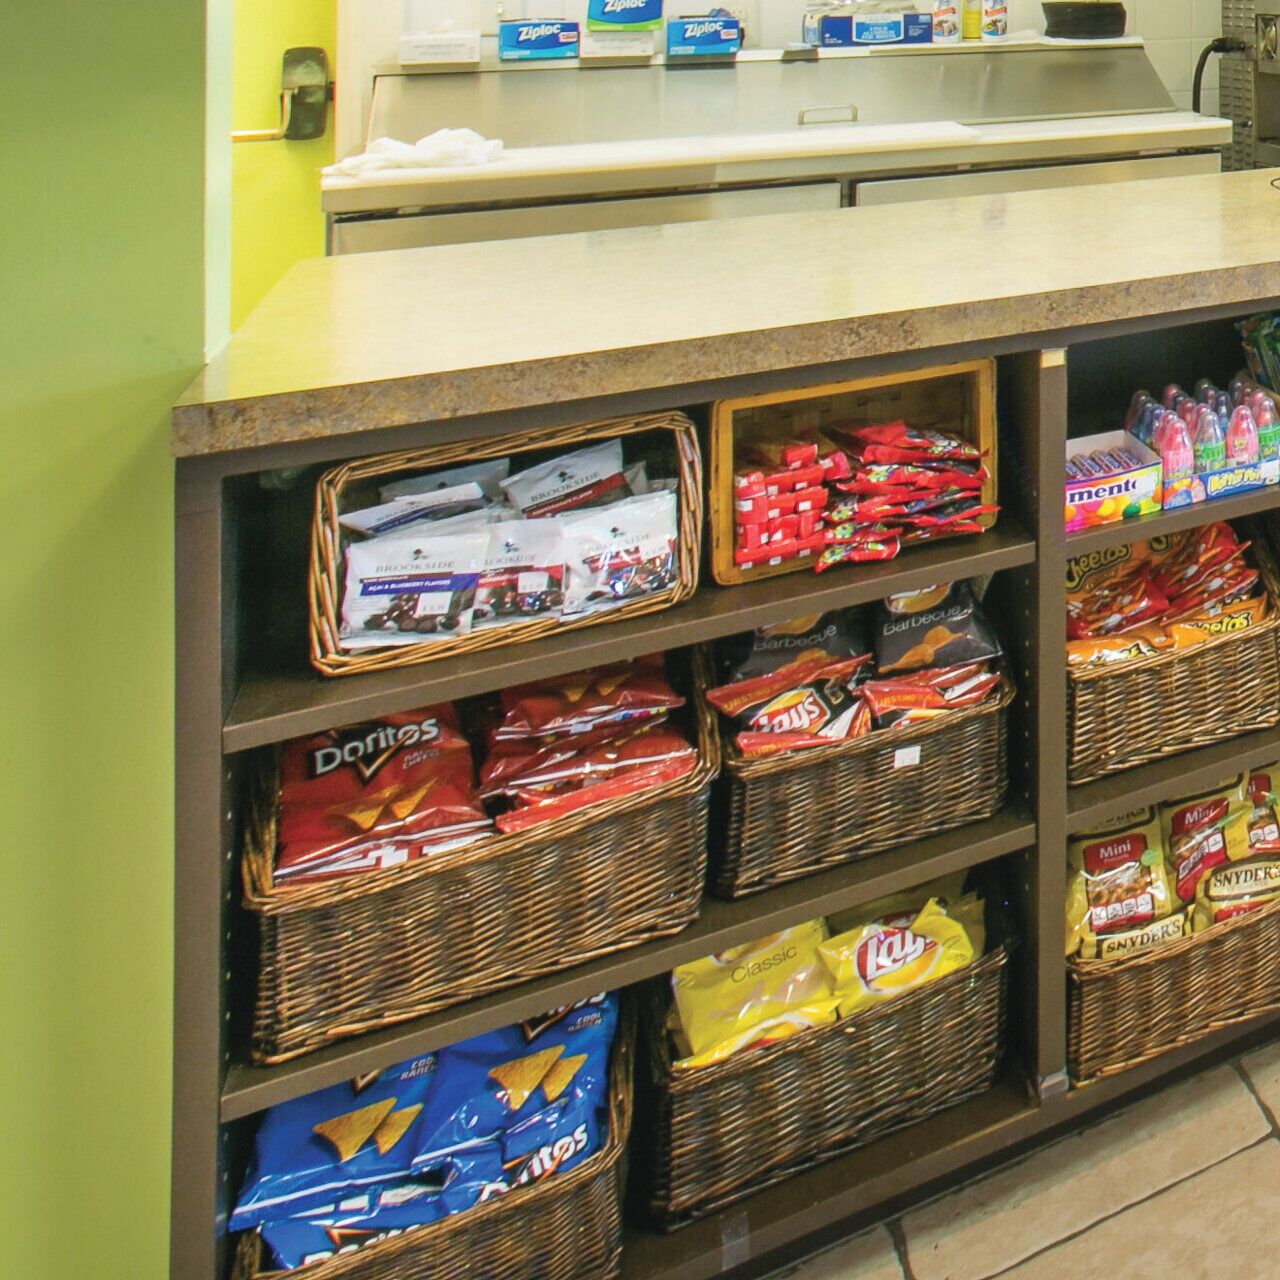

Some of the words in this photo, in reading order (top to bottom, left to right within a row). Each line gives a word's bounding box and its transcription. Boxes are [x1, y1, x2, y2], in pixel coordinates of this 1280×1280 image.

[517, 22, 562, 42] Ziploc
[684, 21, 724, 38] Ziploc
[530, 470, 601, 503] BROOKSIDE
[375, 560, 456, 574] BROOKSIDE
[883, 603, 962, 636] Barbecue
[753, 624, 838, 652] Barbecue
[314, 717, 440, 776] Doritos
[1184, 804, 1215, 826] Mini
[1100, 839, 1132, 860] Mini
[1105, 918, 1182, 954] SNYDER'S
[730, 943, 798, 985] Classic
